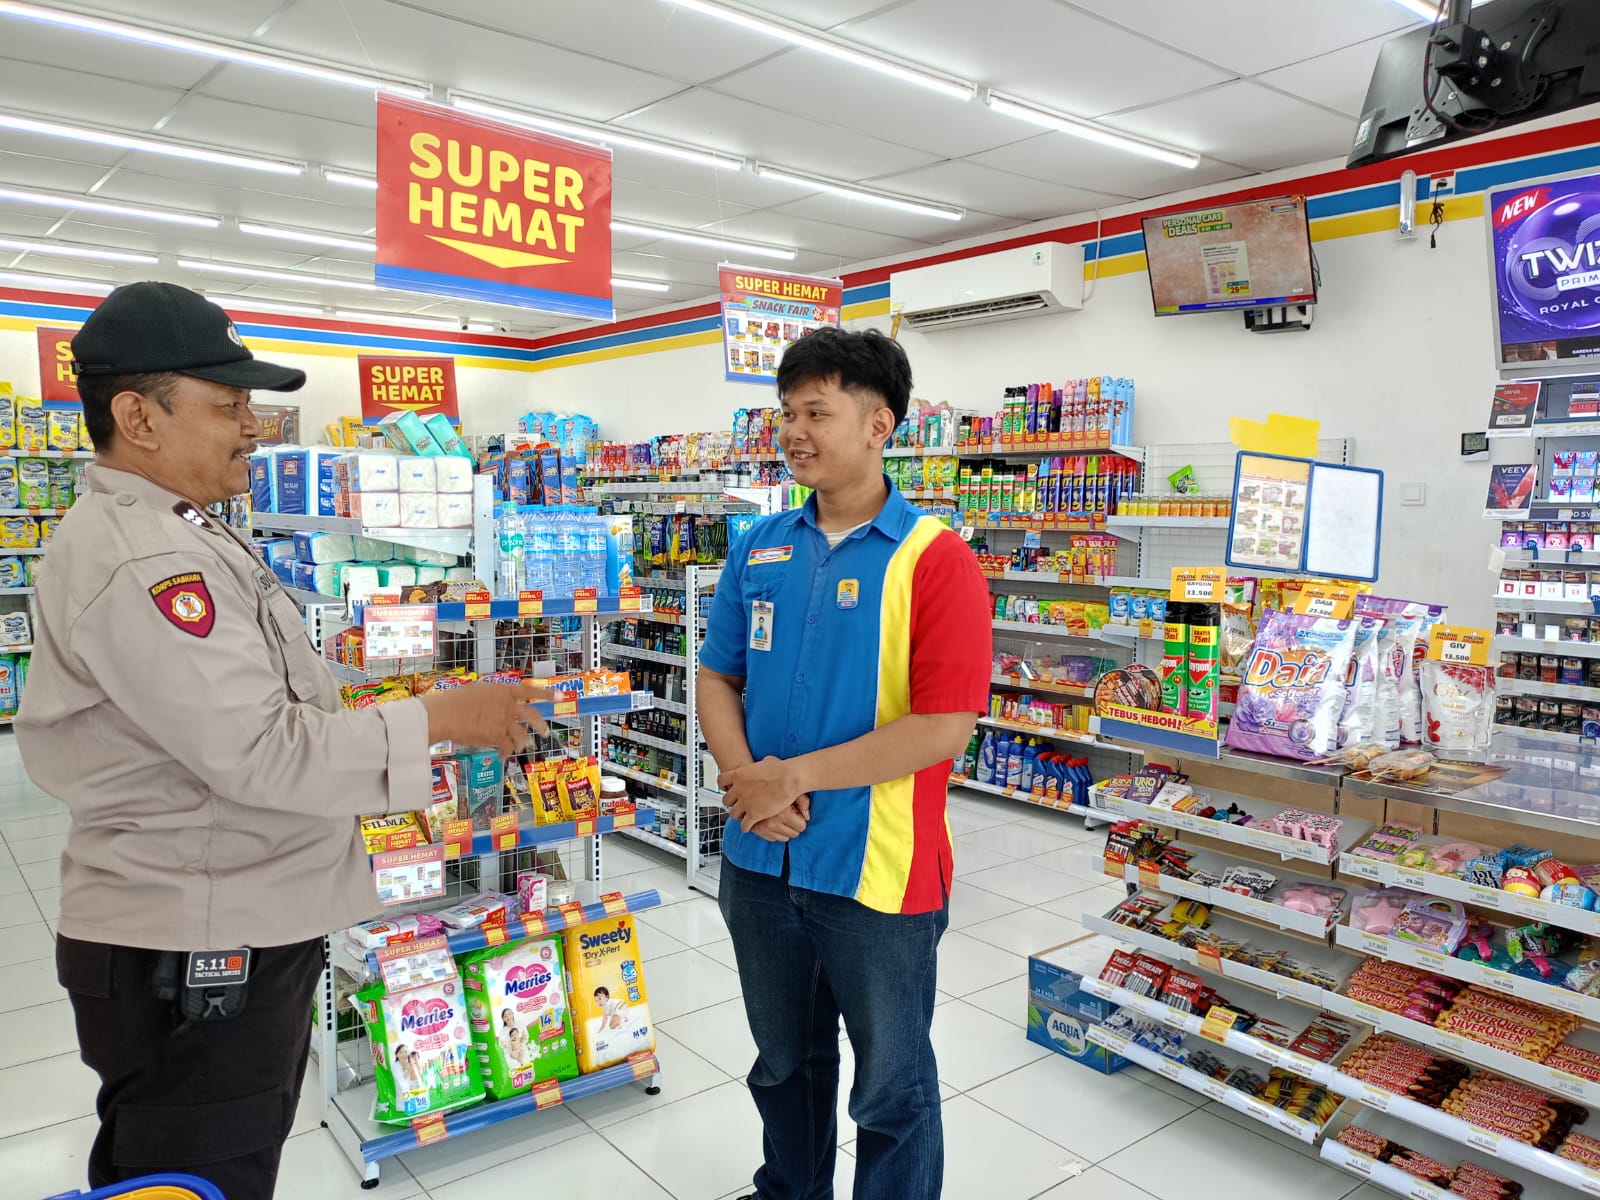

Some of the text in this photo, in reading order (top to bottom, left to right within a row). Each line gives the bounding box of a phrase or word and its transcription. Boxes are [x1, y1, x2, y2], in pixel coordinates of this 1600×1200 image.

[409, 132, 585, 211] SUPER
[1501, 190, 1540, 223] NEW
[408, 182, 585, 253] HEMAT
[1162, 215, 1201, 228] PERSONAL
[1202, 212, 1223, 222] CARE
[1168, 224, 1198, 237] DEALS
[735, 275, 828, 301] SUPER HEMAT
[752, 299, 785, 314] SNACK
[787, 305, 810, 317] FAIR
[1540, 299, 1589, 316] ROYAL
[371, 365, 444, 385] SUPER
[372, 385, 445, 402] HEMAT
[1501, 466, 1528, 474] VEEV
[151, 580, 173, 596] KORPS
[1314, 599, 1334, 607] DAIA
[1445, 653, 1470, 661] 13.500
[1247, 650, 1330, 686] Daia
[1109, 707, 1182, 730] TEBUS HEBOH!
[1134, 776, 1156, 787] UNO
[363, 816, 408, 830] FILMA
[448, 826, 469, 834] HEMAT
[390, 833, 412, 841] SUPER
[390, 838, 412, 846] HEMAT
[382, 850, 439, 864] SUPER HEMAT
[580, 927, 631, 949] Sweety
[384, 939, 441, 956] SUPER HEMAT
[584, 951, 599, 960] Dry
[195, 957, 227, 971] 5.11
[1135, 960, 1164, 974] EVEREADY
[1366, 959, 1419, 981] SILVERQUEEN
[194, 969, 241, 978] TACTICAL SERIES
[1170, 975, 1199, 990] EVEREADY
[1355, 970, 1409, 993] SILVERQUEEN
[504, 971, 552, 996] Merries
[1350, 984, 1404, 1009] SILVERQUEEN
[1470, 991, 1544, 1024] SILVERQUEEN
[401, 1008, 454, 1032] Merries
[1462, 1006, 1537, 1037] SILVERQUEEN
[1052, 1019, 1081, 1041] AQUA
[1449, 1014, 1525, 1046] SILVERQUEEN
[1484, 1085, 1540, 1108] SILVERQUEEN
[1477, 1093, 1534, 1119] SILVERQUEEN
[1466, 1106, 1523, 1130] SILVERQUEEN
